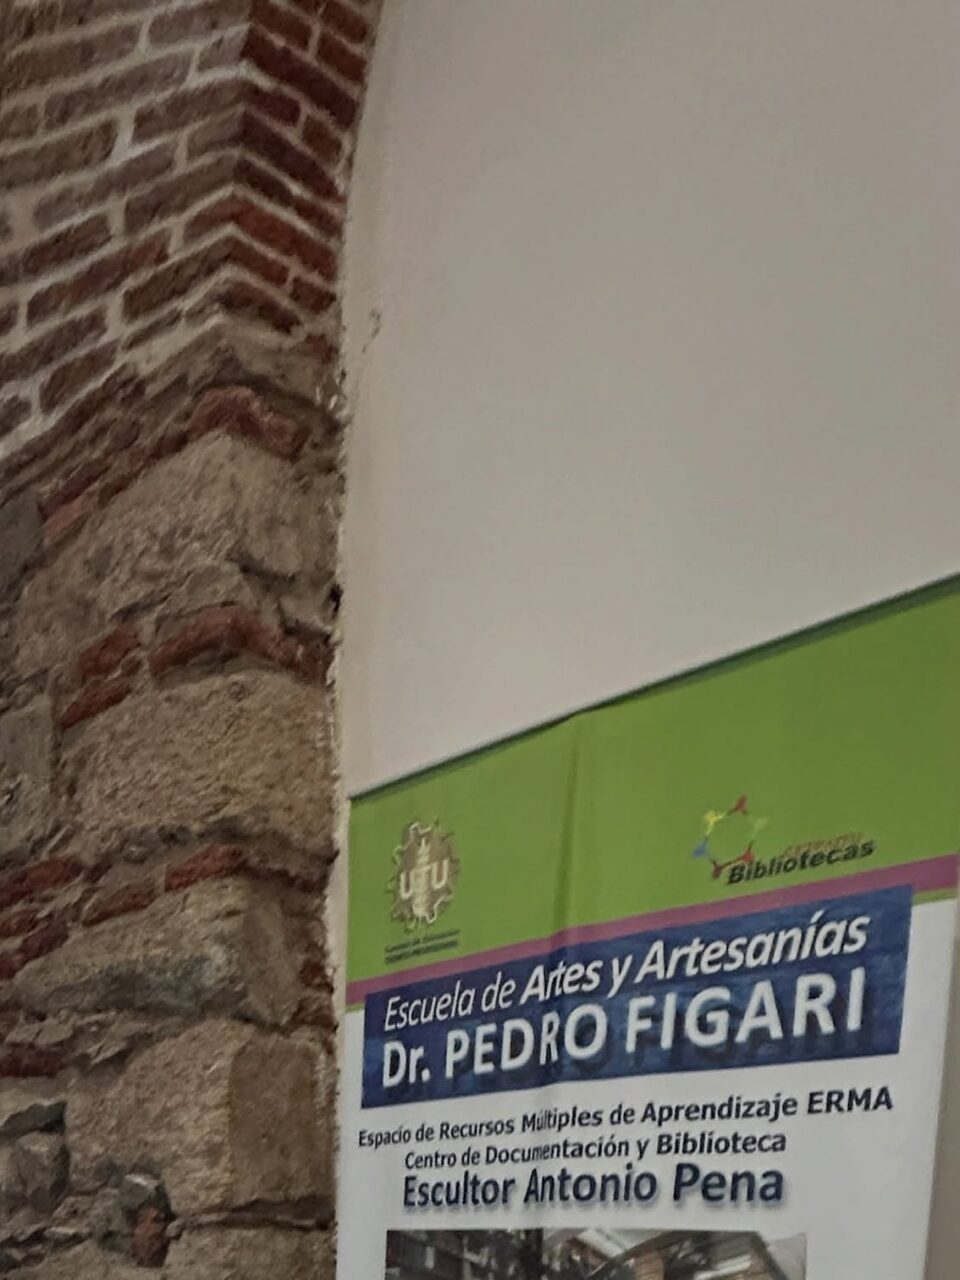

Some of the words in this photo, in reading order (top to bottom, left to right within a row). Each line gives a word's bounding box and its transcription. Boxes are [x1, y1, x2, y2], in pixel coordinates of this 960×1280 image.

[727, 840, 875, 884] Bibliotecas
[384, 980, 475, 1032] Escuela
[481, 971, 517, 1012] de
[520, 960, 603, 1004] Artes
[607, 954, 633, 998] y
[634, 909, 871, 983] Artesanías
[382, 1040, 431, 1088] Dr.
[445, 1003, 608, 1079] PEDRO
[625, 966, 865, 1053] FIGARI
[358, 1125, 411, 1150] Espacio
[415, 1122, 434, 1142] de
[440, 1118, 515, 1141] Recursos
[521, 1105, 603, 1133] Múltiples
[609, 1102, 635, 1125] de
[641, 1093, 798, 1127] Aprendizaje
[807, 1086, 894, 1115] ERMA
[405, 1150, 457, 1170] Centro
[461, 1147, 480, 1166] de
[485, 1134, 629, 1165] Documentación
[637, 1138, 650, 1161] y
[656, 1131, 787, 1155] Biblioteca
[403, 1170, 515, 1208] Escultor
[523, 1163, 657, 1205] Antonio
[673, 1162, 784, 1203] Pena
